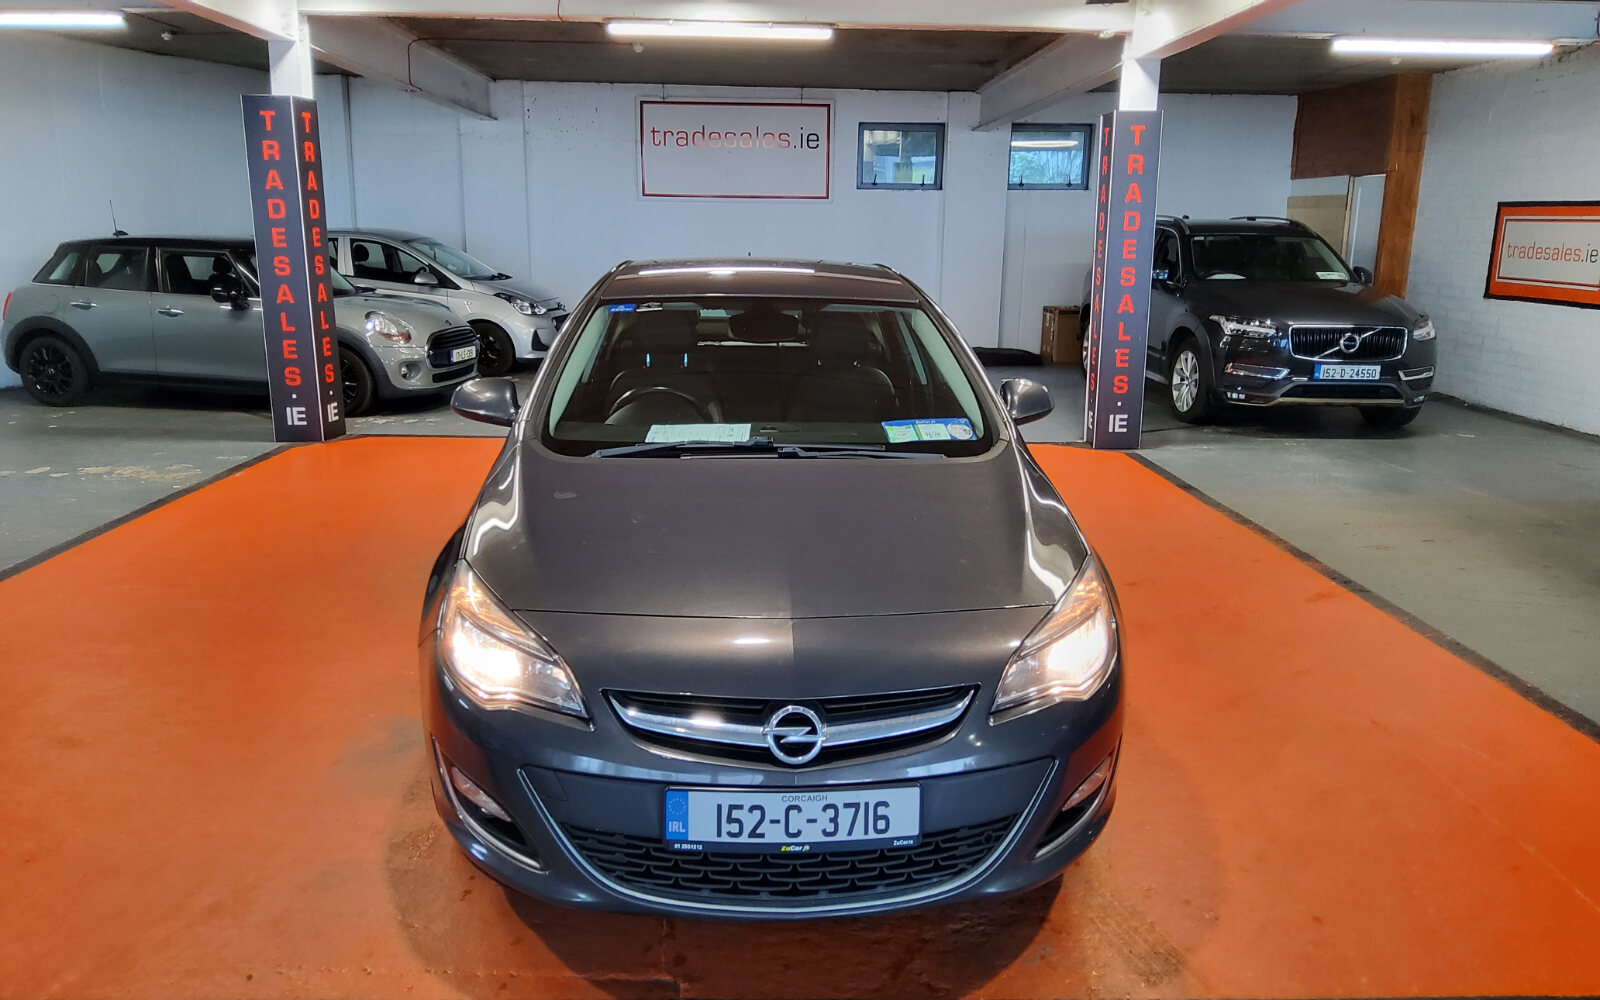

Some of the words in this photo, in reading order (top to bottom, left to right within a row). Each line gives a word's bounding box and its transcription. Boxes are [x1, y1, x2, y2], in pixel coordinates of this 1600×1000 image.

[650, 125, 820, 150] tradesales.ie
[1507, 241, 1599, 264] tradesales.ie
[1322, 368, 1377, 379] 152-D-24550
[781, 794, 828, 803] CORCAIGH
[668, 820, 686, 833] IRL
[716, 801, 891, 839] 152-C-3716
